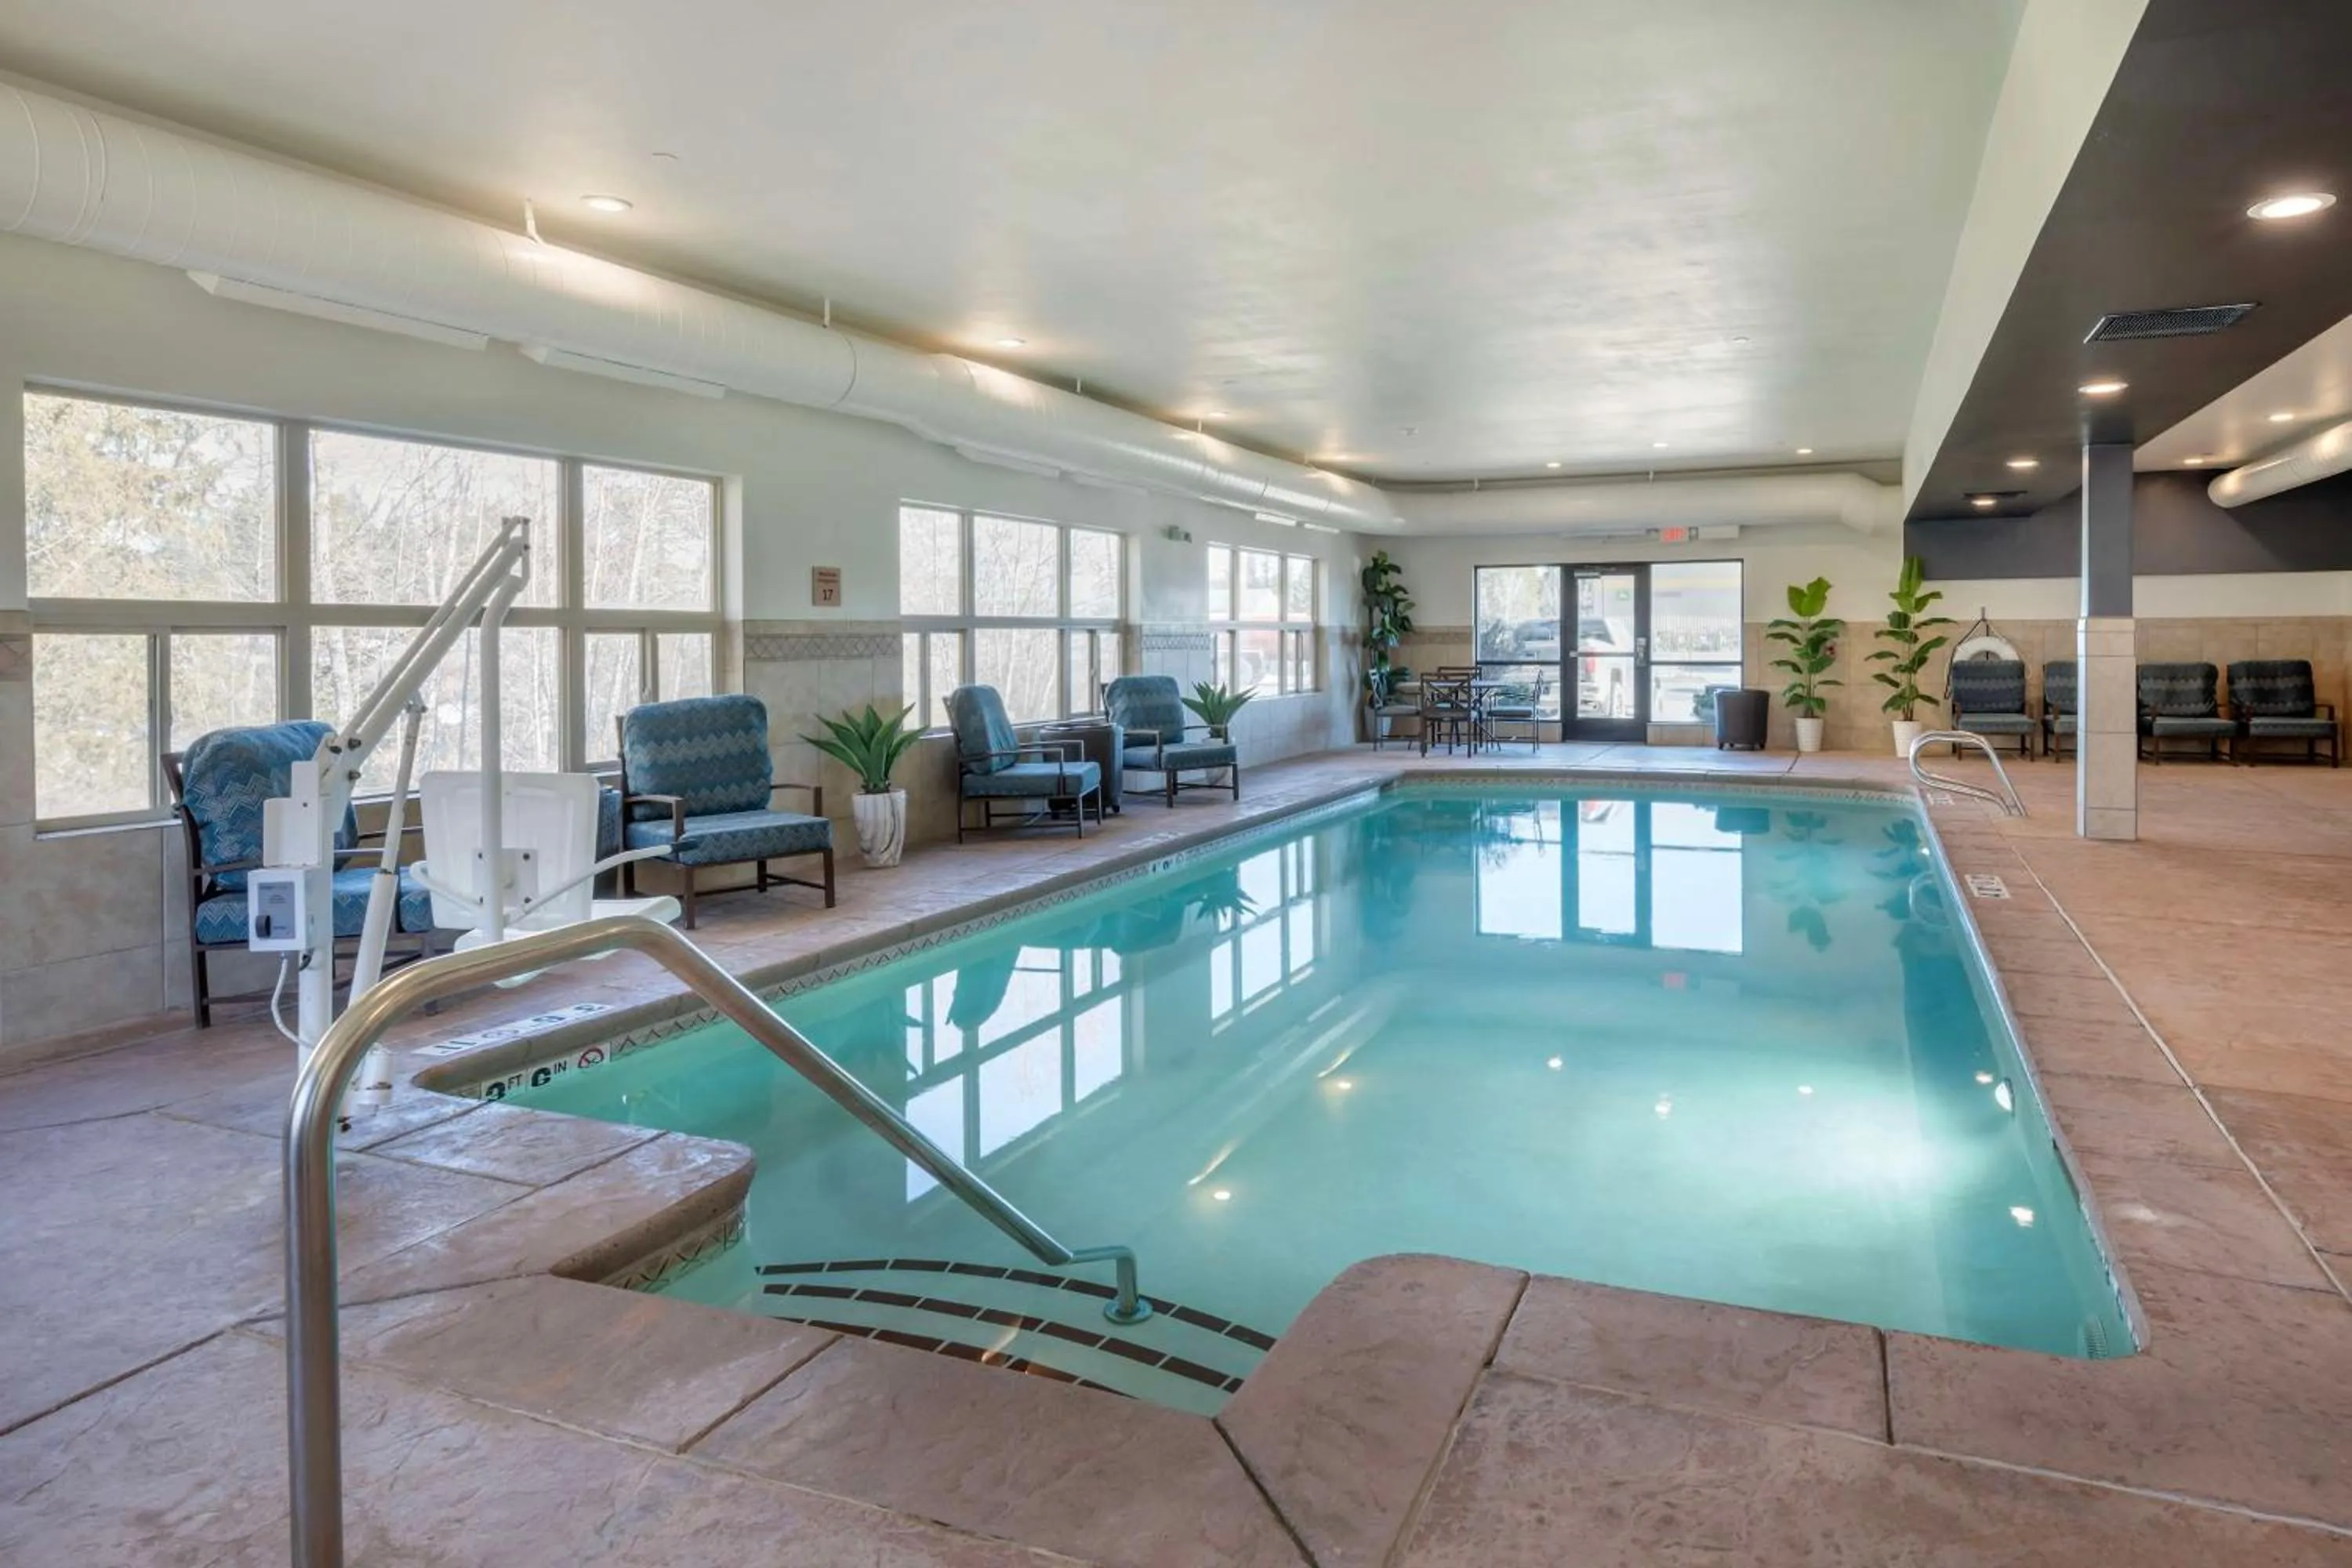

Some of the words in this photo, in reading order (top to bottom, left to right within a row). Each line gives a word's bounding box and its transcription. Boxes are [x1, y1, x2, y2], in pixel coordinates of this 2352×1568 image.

[822, 589, 833, 601] 17
[507, 1073, 523, 1091] FT
[554, 1060, 567, 1075] IN
